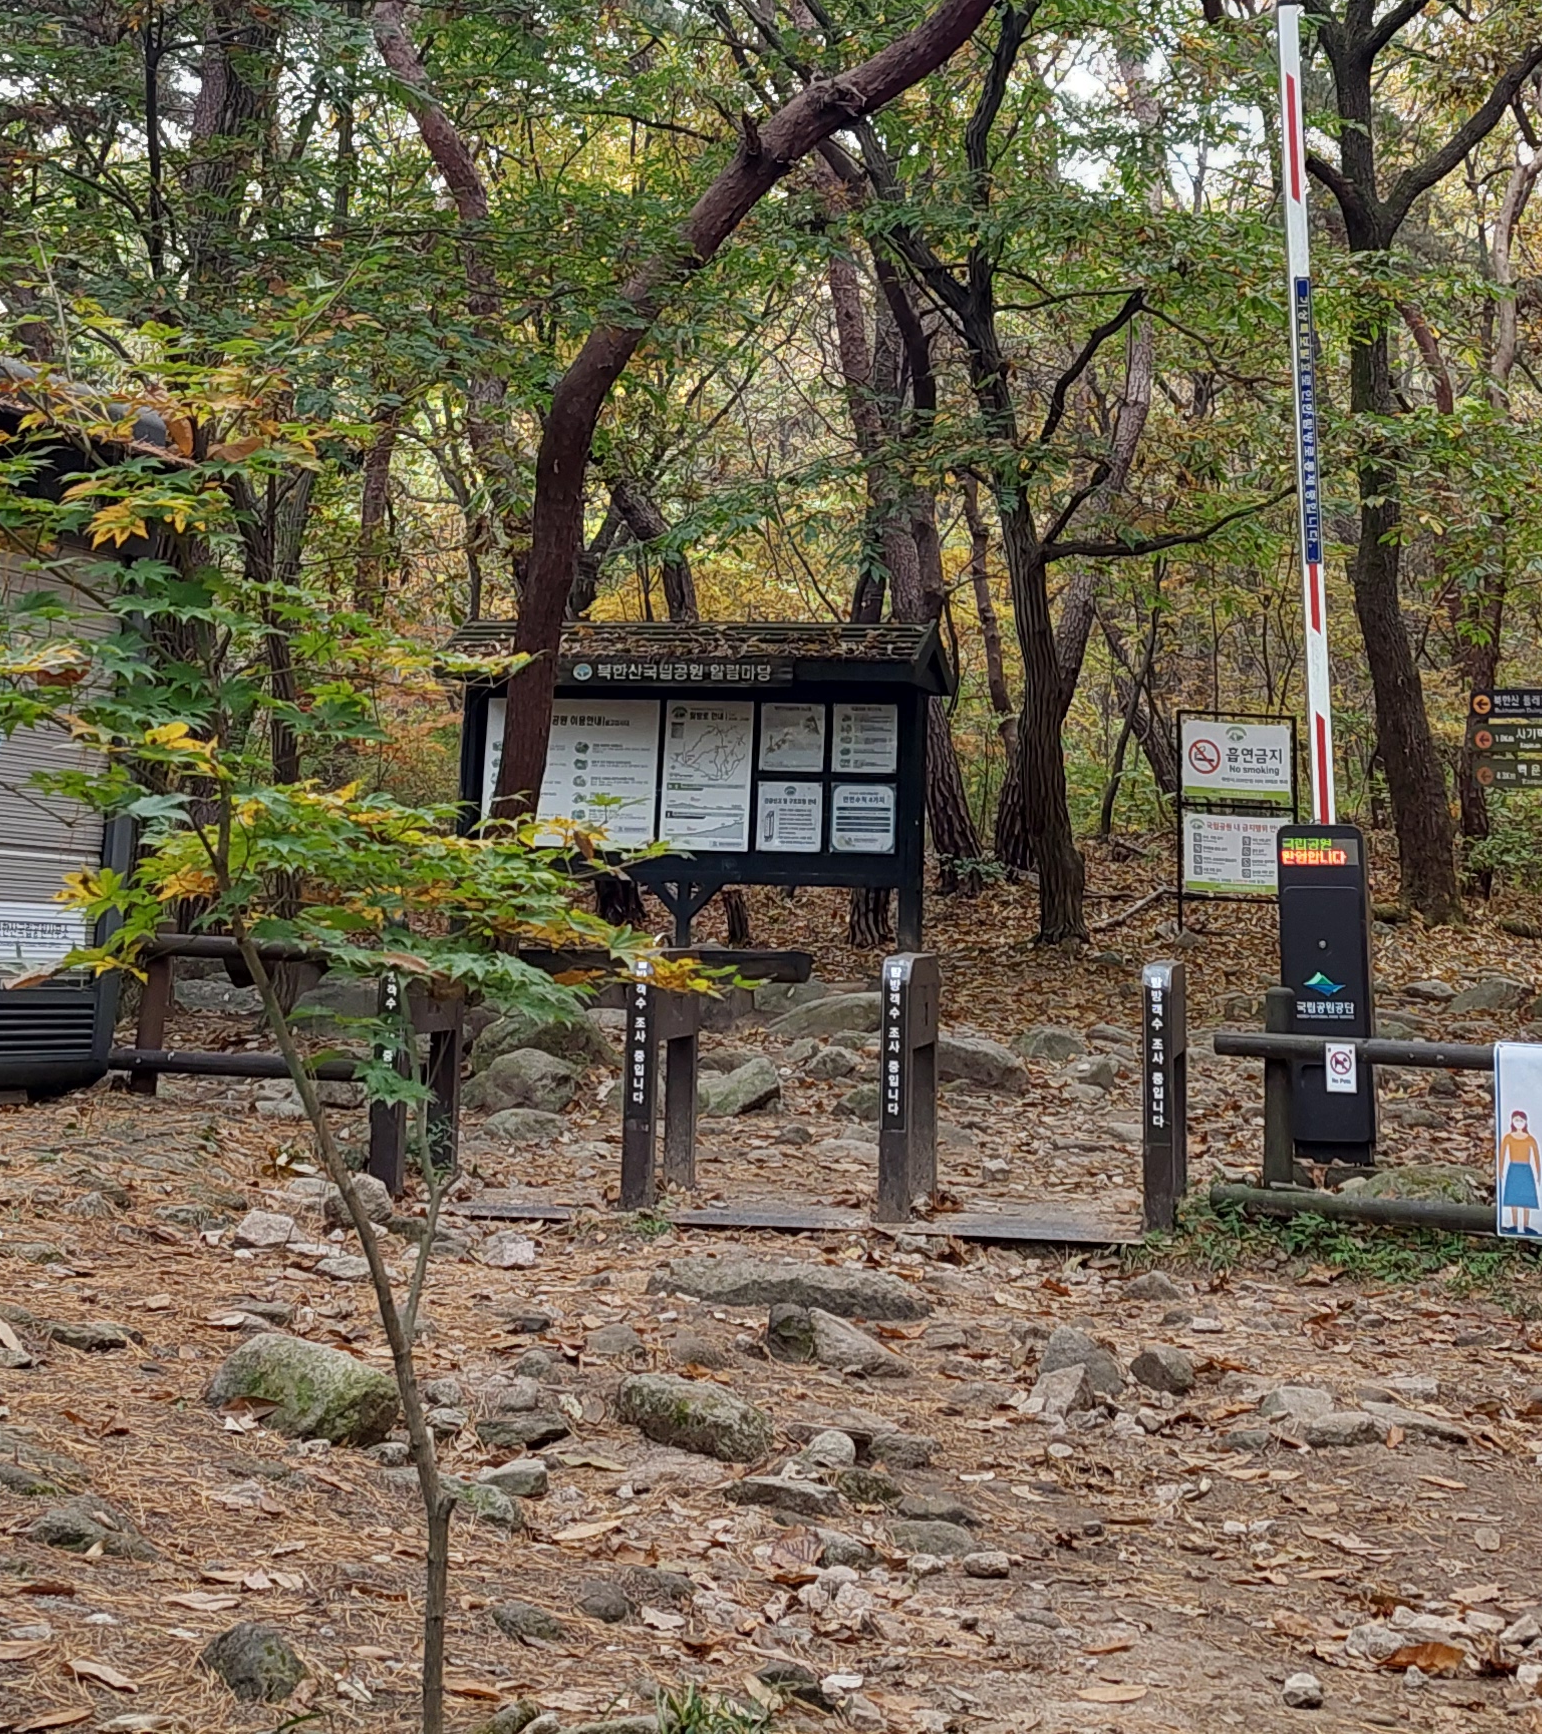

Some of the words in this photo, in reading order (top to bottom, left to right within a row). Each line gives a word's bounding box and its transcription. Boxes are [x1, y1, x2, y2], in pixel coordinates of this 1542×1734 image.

[597, 662, 706, 681] 북한산국립공원
[710, 663, 772, 682] 알림마당
[1493, 695, 1519, 706] 북한산
[1226, 747, 1283, 764] 흡연금지
[1229, 765, 1241, 774] No
[1243, 766, 1280, 776] smoking
[1206, 821, 1232, 832] 국립공원
[1282, 838, 1332, 851] 국립공원
[889, 967, 902, 1020] 탐방객수
[1150, 977, 1164, 1031] 탐방객수
[1296, 1001, 1355, 1014] 국립공원공단
[634, 1017, 647, 1044] 조사
[888, 1027, 900, 1054] 조사
[1151, 1038, 1164, 1065] 조사
[632, 1050, 646, 1105] 중입니다
[887, 1060, 900, 1116] 중입니다
[1151, 1072, 1165, 1129] 중입니다
